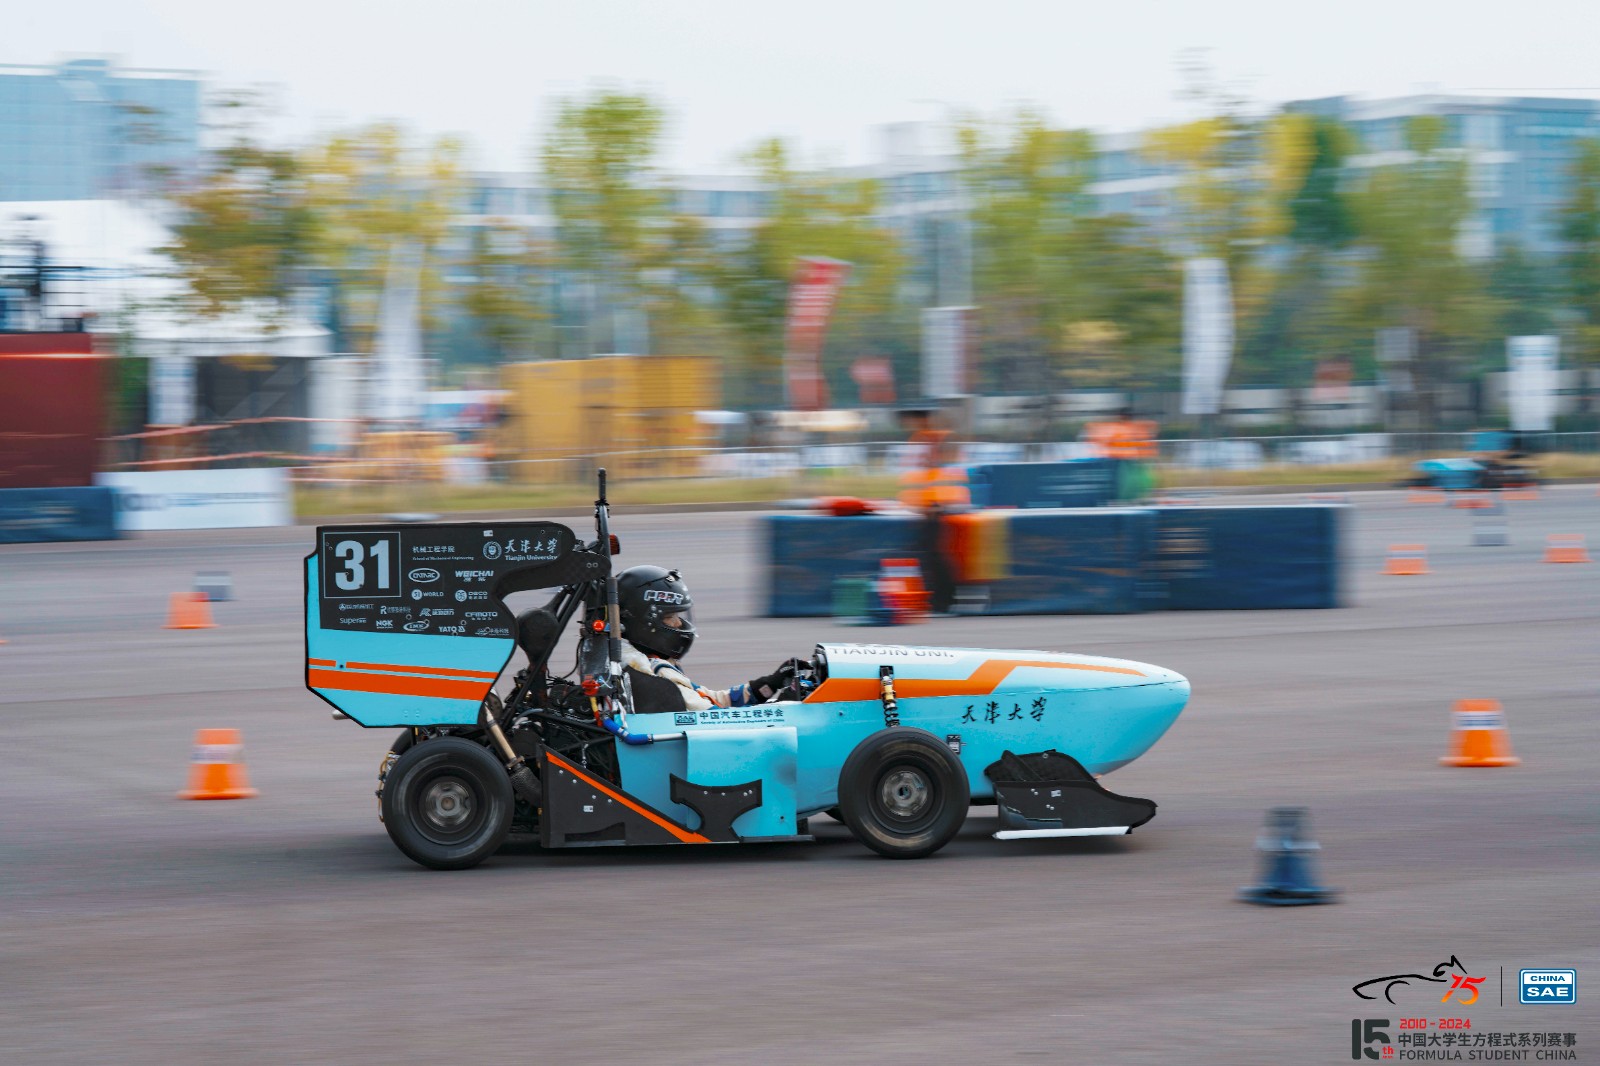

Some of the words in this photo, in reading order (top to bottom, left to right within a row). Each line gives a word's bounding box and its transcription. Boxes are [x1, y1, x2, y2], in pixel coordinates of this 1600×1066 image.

[412, 545, 456, 553] 机械工程学院
[505, 537, 558, 554] 天津大学
[335, 540, 390, 591] 31
[700, 709, 783, 719] 中国汽车工程学会
[961, 697, 1047, 724] 天津大学
